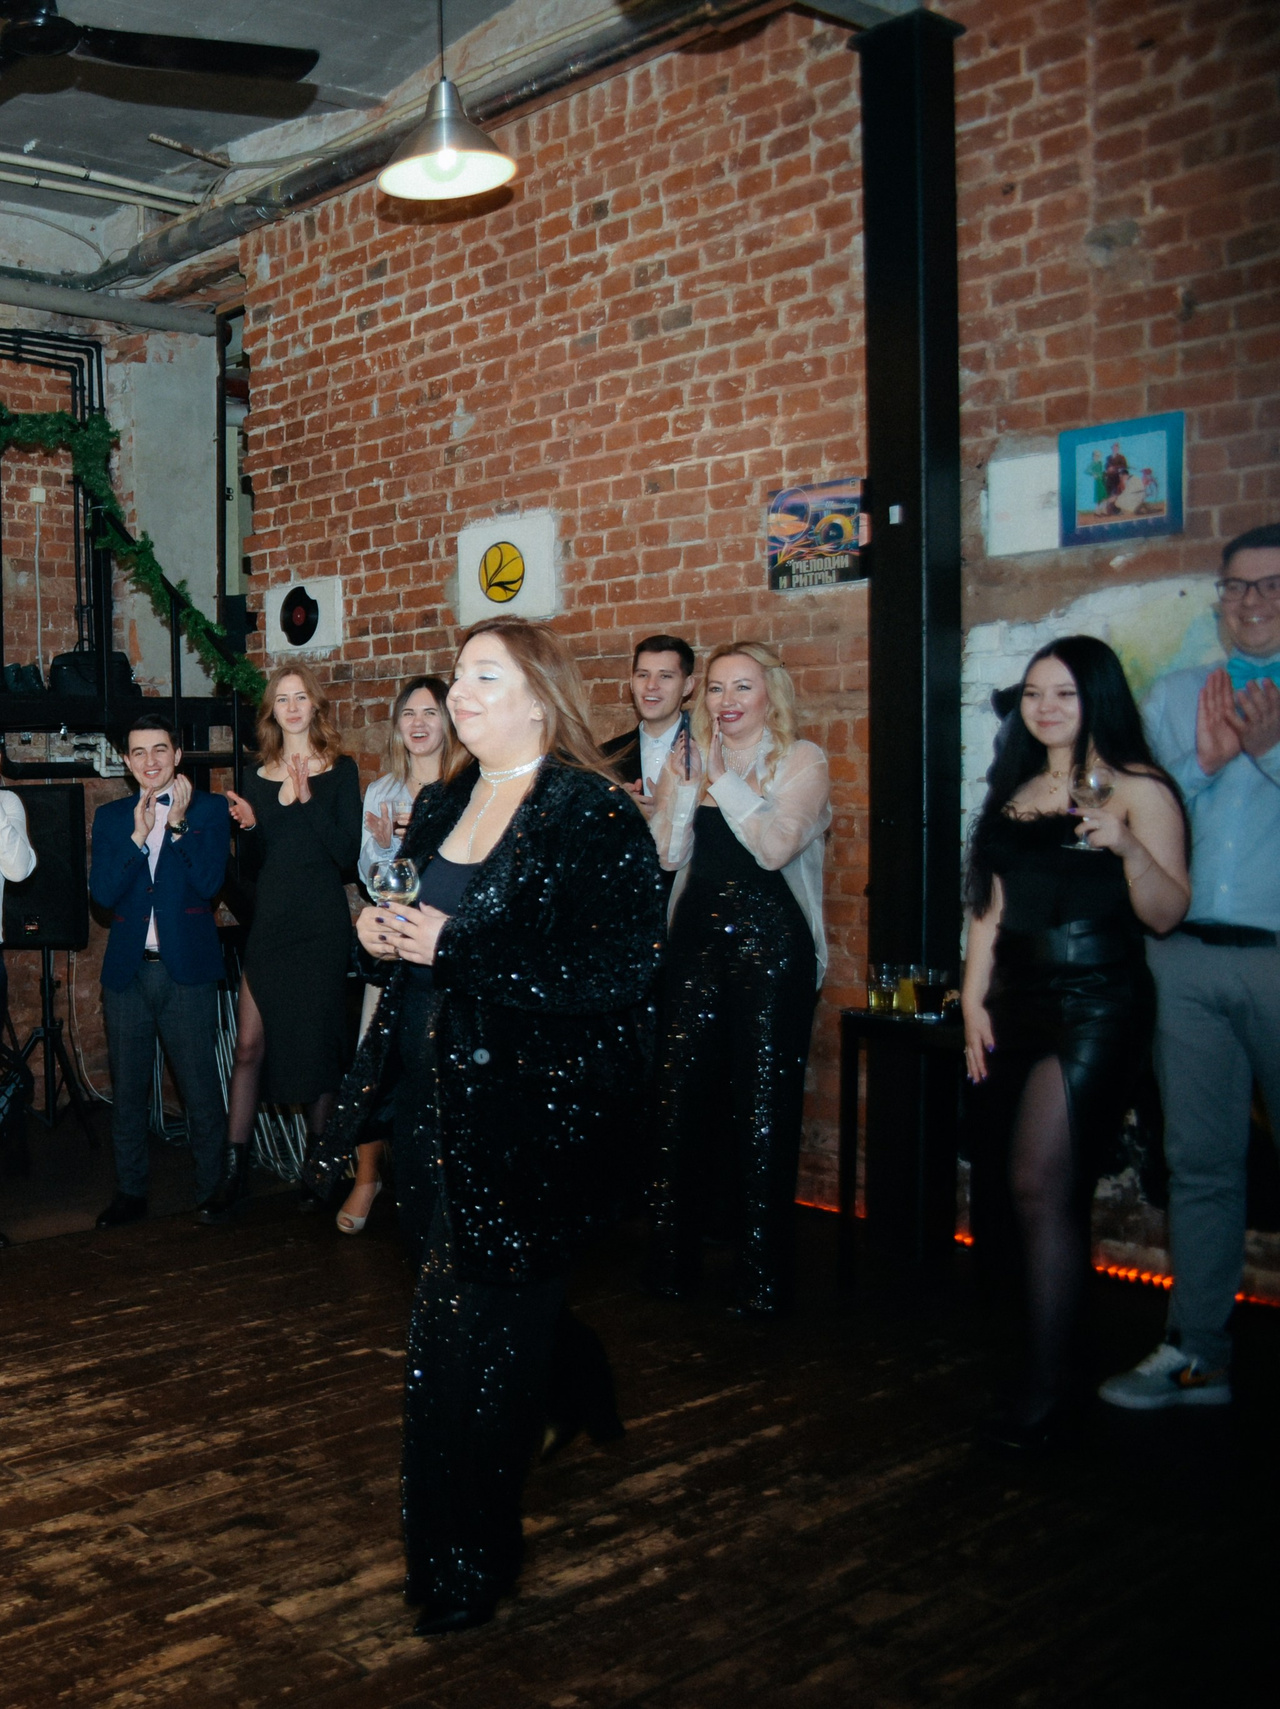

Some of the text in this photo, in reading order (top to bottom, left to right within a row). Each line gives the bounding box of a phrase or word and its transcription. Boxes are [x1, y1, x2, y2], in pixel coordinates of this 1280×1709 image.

[791, 554, 849, 574] МЕЛОДИИ
[779, 570, 836, 589] И РИТМЫ
